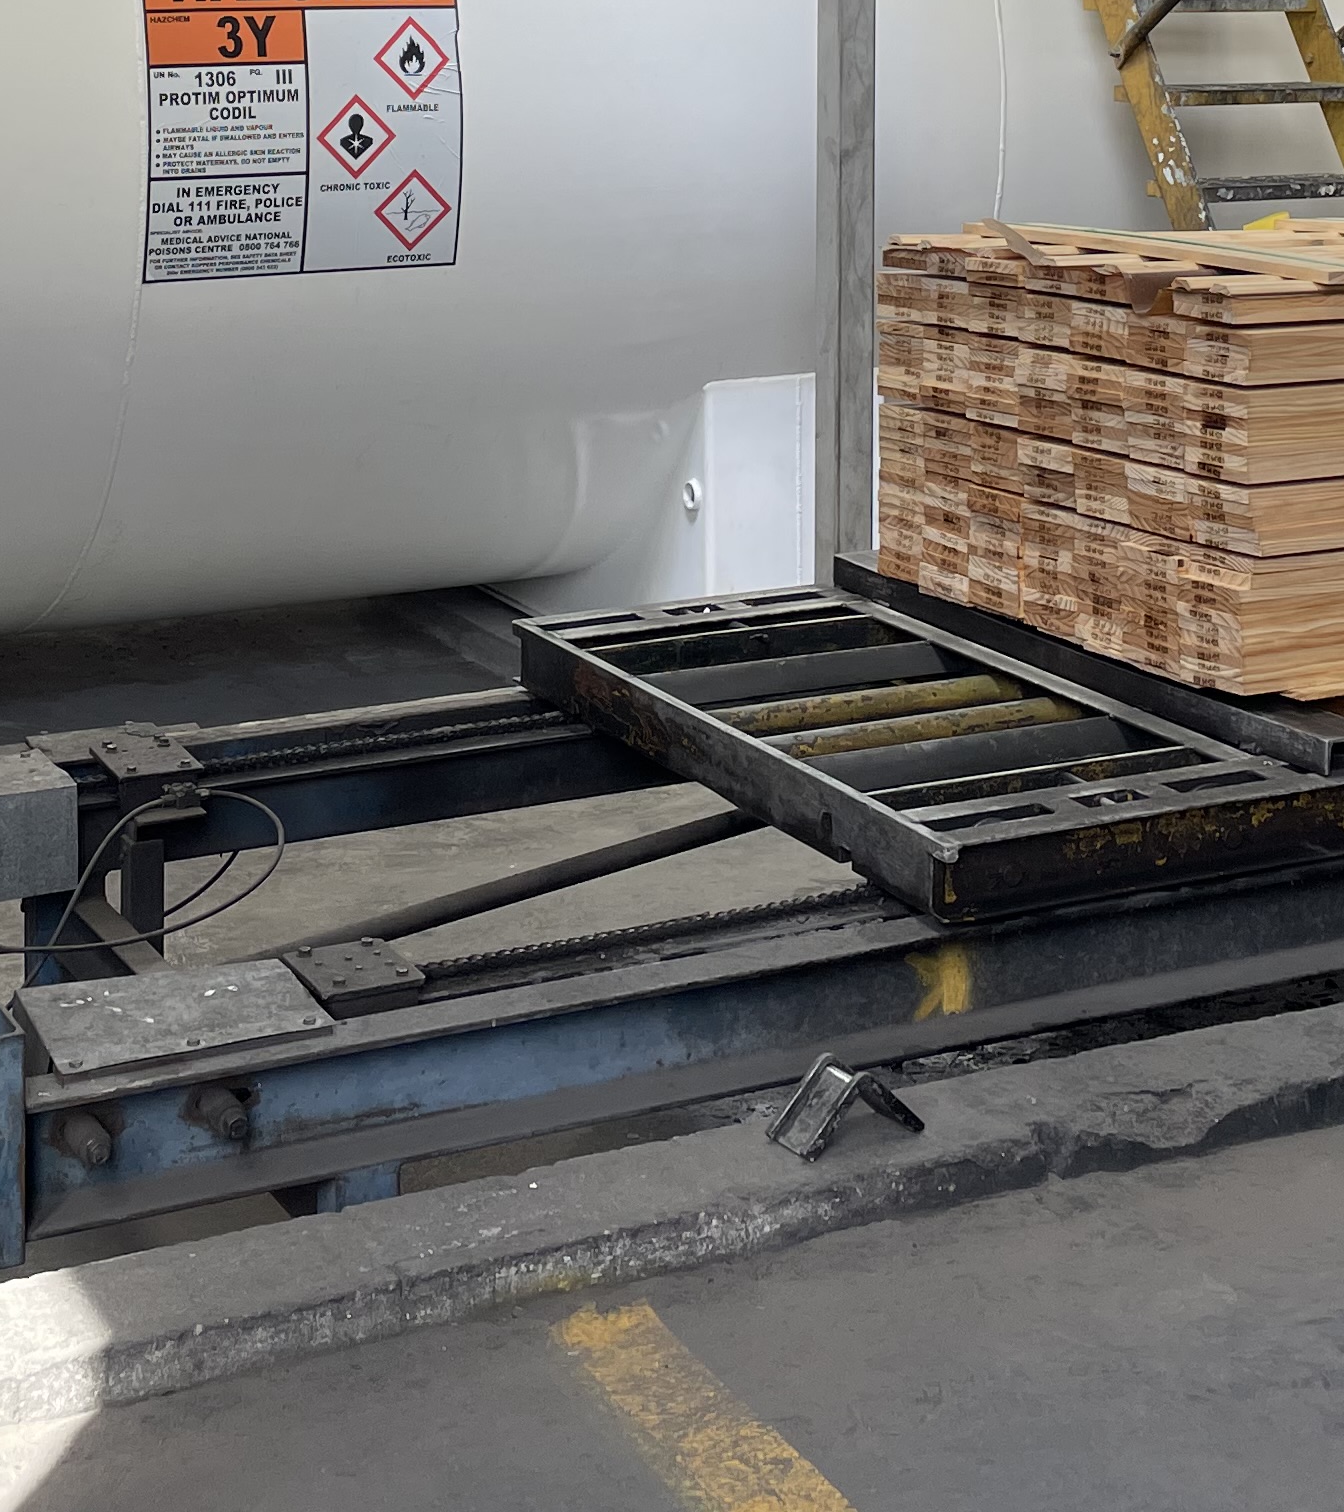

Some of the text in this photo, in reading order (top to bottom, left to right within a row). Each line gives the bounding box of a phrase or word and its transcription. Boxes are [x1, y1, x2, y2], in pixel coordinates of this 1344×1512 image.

[150, 15, 190, 23] HAZCHEM
[216, 15, 276, 59] 3Y
[194, 71, 236, 88] 1306
[276, 69, 293, 85] III
[159, 89, 299, 106] PROTIM OPTIMUM
[209, 106, 256, 120] CODIL
[386, 103, 439, 113] FLAMMABLE
[162, 123, 273, 135] FLAMMABLE LIQUID AND VAPOUR
[188, 135, 209, 143] FATAL
[219, 133, 261, 142] SWALLOWED
[179, 151, 202, 159] CAUSE
[203, 150, 213, 158] AN
[215, 149, 248, 158] ALLERGIC
[267, 147, 301, 155] REACTION
[162, 160, 194, 168] PROTECT
[252, 157, 266, 165] NOT
[268, 156, 291, 164] EMPTY
[163, 167, 207, 175] INTO DRAINS
[176, 182, 281, 198] IN EMERGENCY
[320, 181, 391, 193] CHRONIC TOXIC
[152, 196, 303, 214] DIAL 111 FIRE, POLICE
[173, 211, 282, 227] OR AMBULANCE
[160, 231, 293, 246] MEDICAL ADVICE NATIONAL
[148, 245, 192, 256] POISONS
[194, 244, 234, 254] CENTRE
[238, 242, 262, 252] 0800
[263, 241, 281, 251] 764
[162, 256, 189, 264] FURTHER
[242, 252, 263, 260] SAFETY
[386, 253, 432, 264] ECOTOXIC
